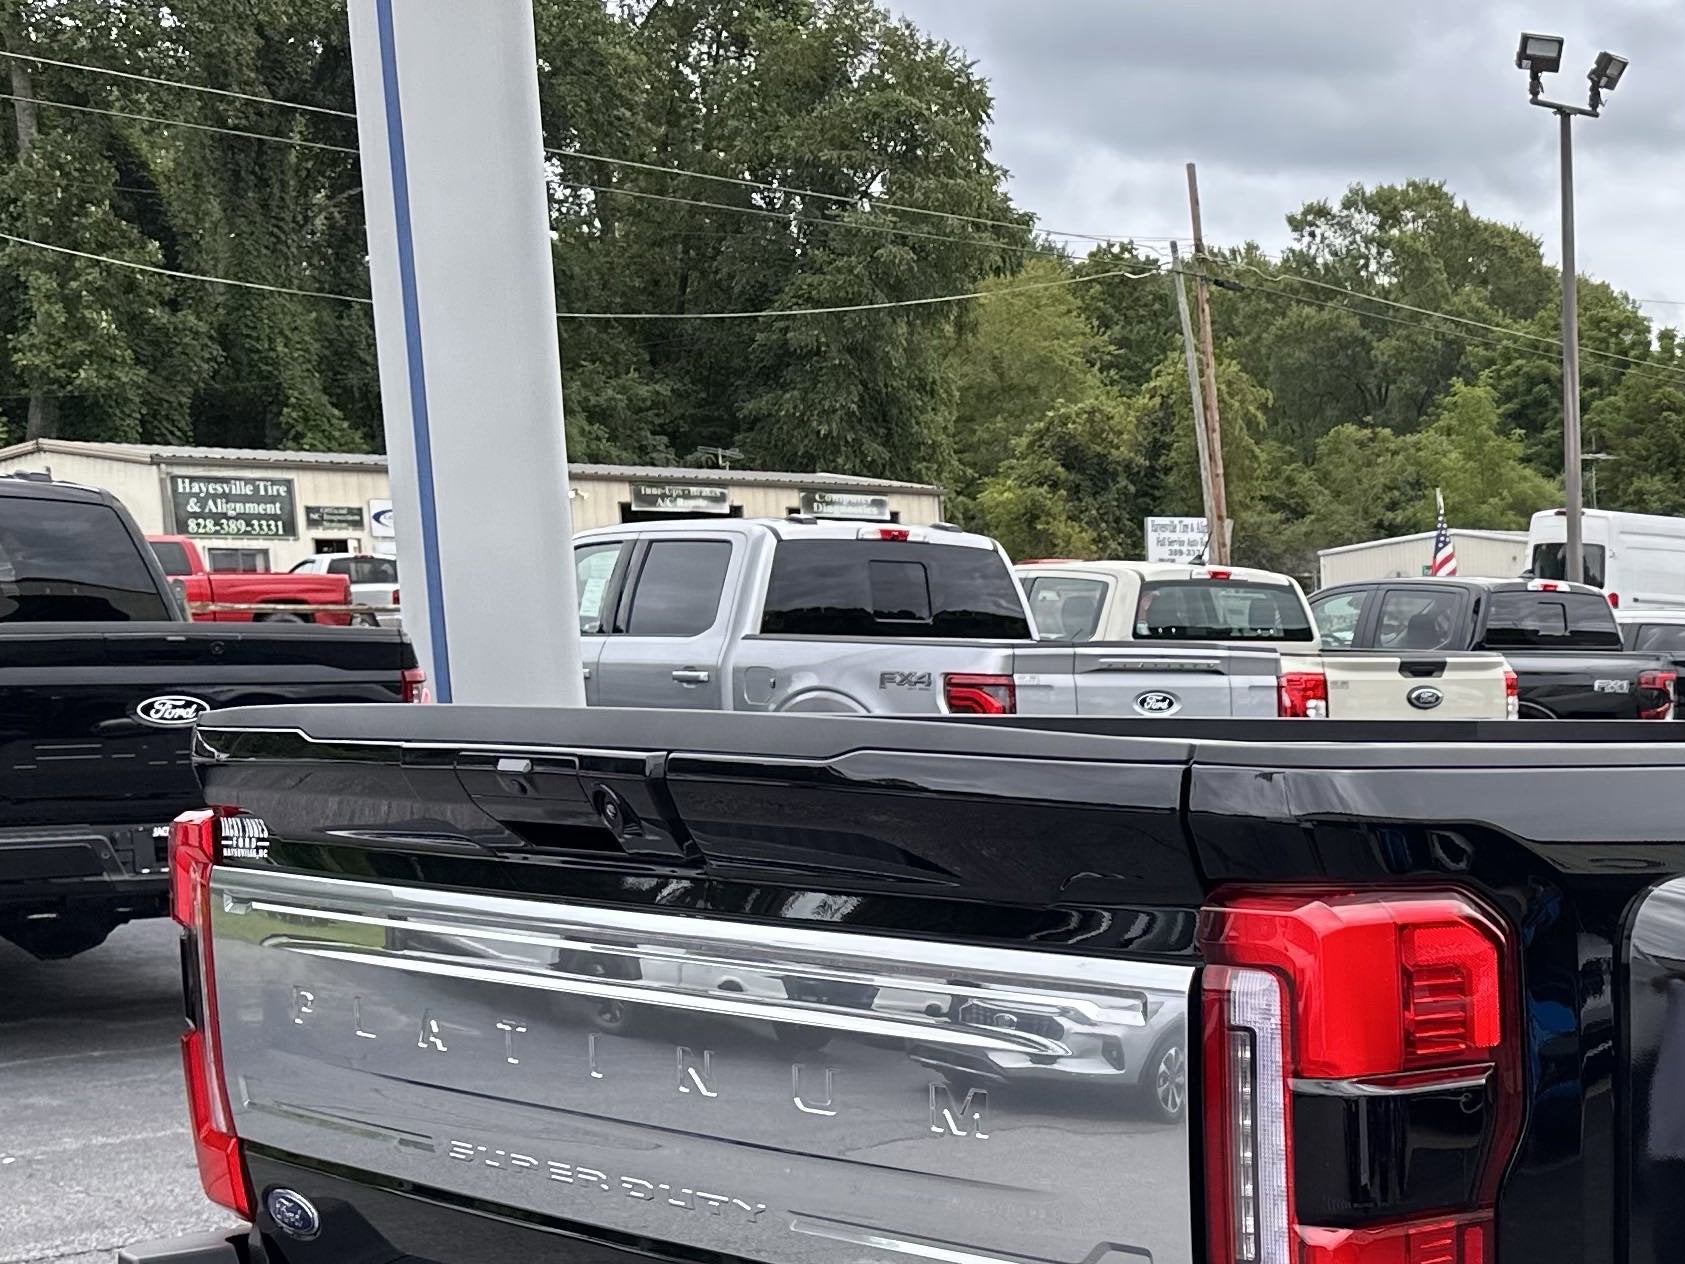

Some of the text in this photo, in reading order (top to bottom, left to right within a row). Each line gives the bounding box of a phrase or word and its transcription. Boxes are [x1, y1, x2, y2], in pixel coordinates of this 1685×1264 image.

[177, 478, 288, 496] Hayesville Tire
[186, 498, 281, 517] & Alignment
[187, 518, 284, 535] 828-389-3331
[879, 671, 932, 689] FX4
[1593, 679, 1630, 694] FX4
[150, 700, 197, 719] Ford
[1144, 695, 1170, 709] Ford
[232, 837, 257, 848] FORD
[293, 985, 989, 1139] PLATINUM
